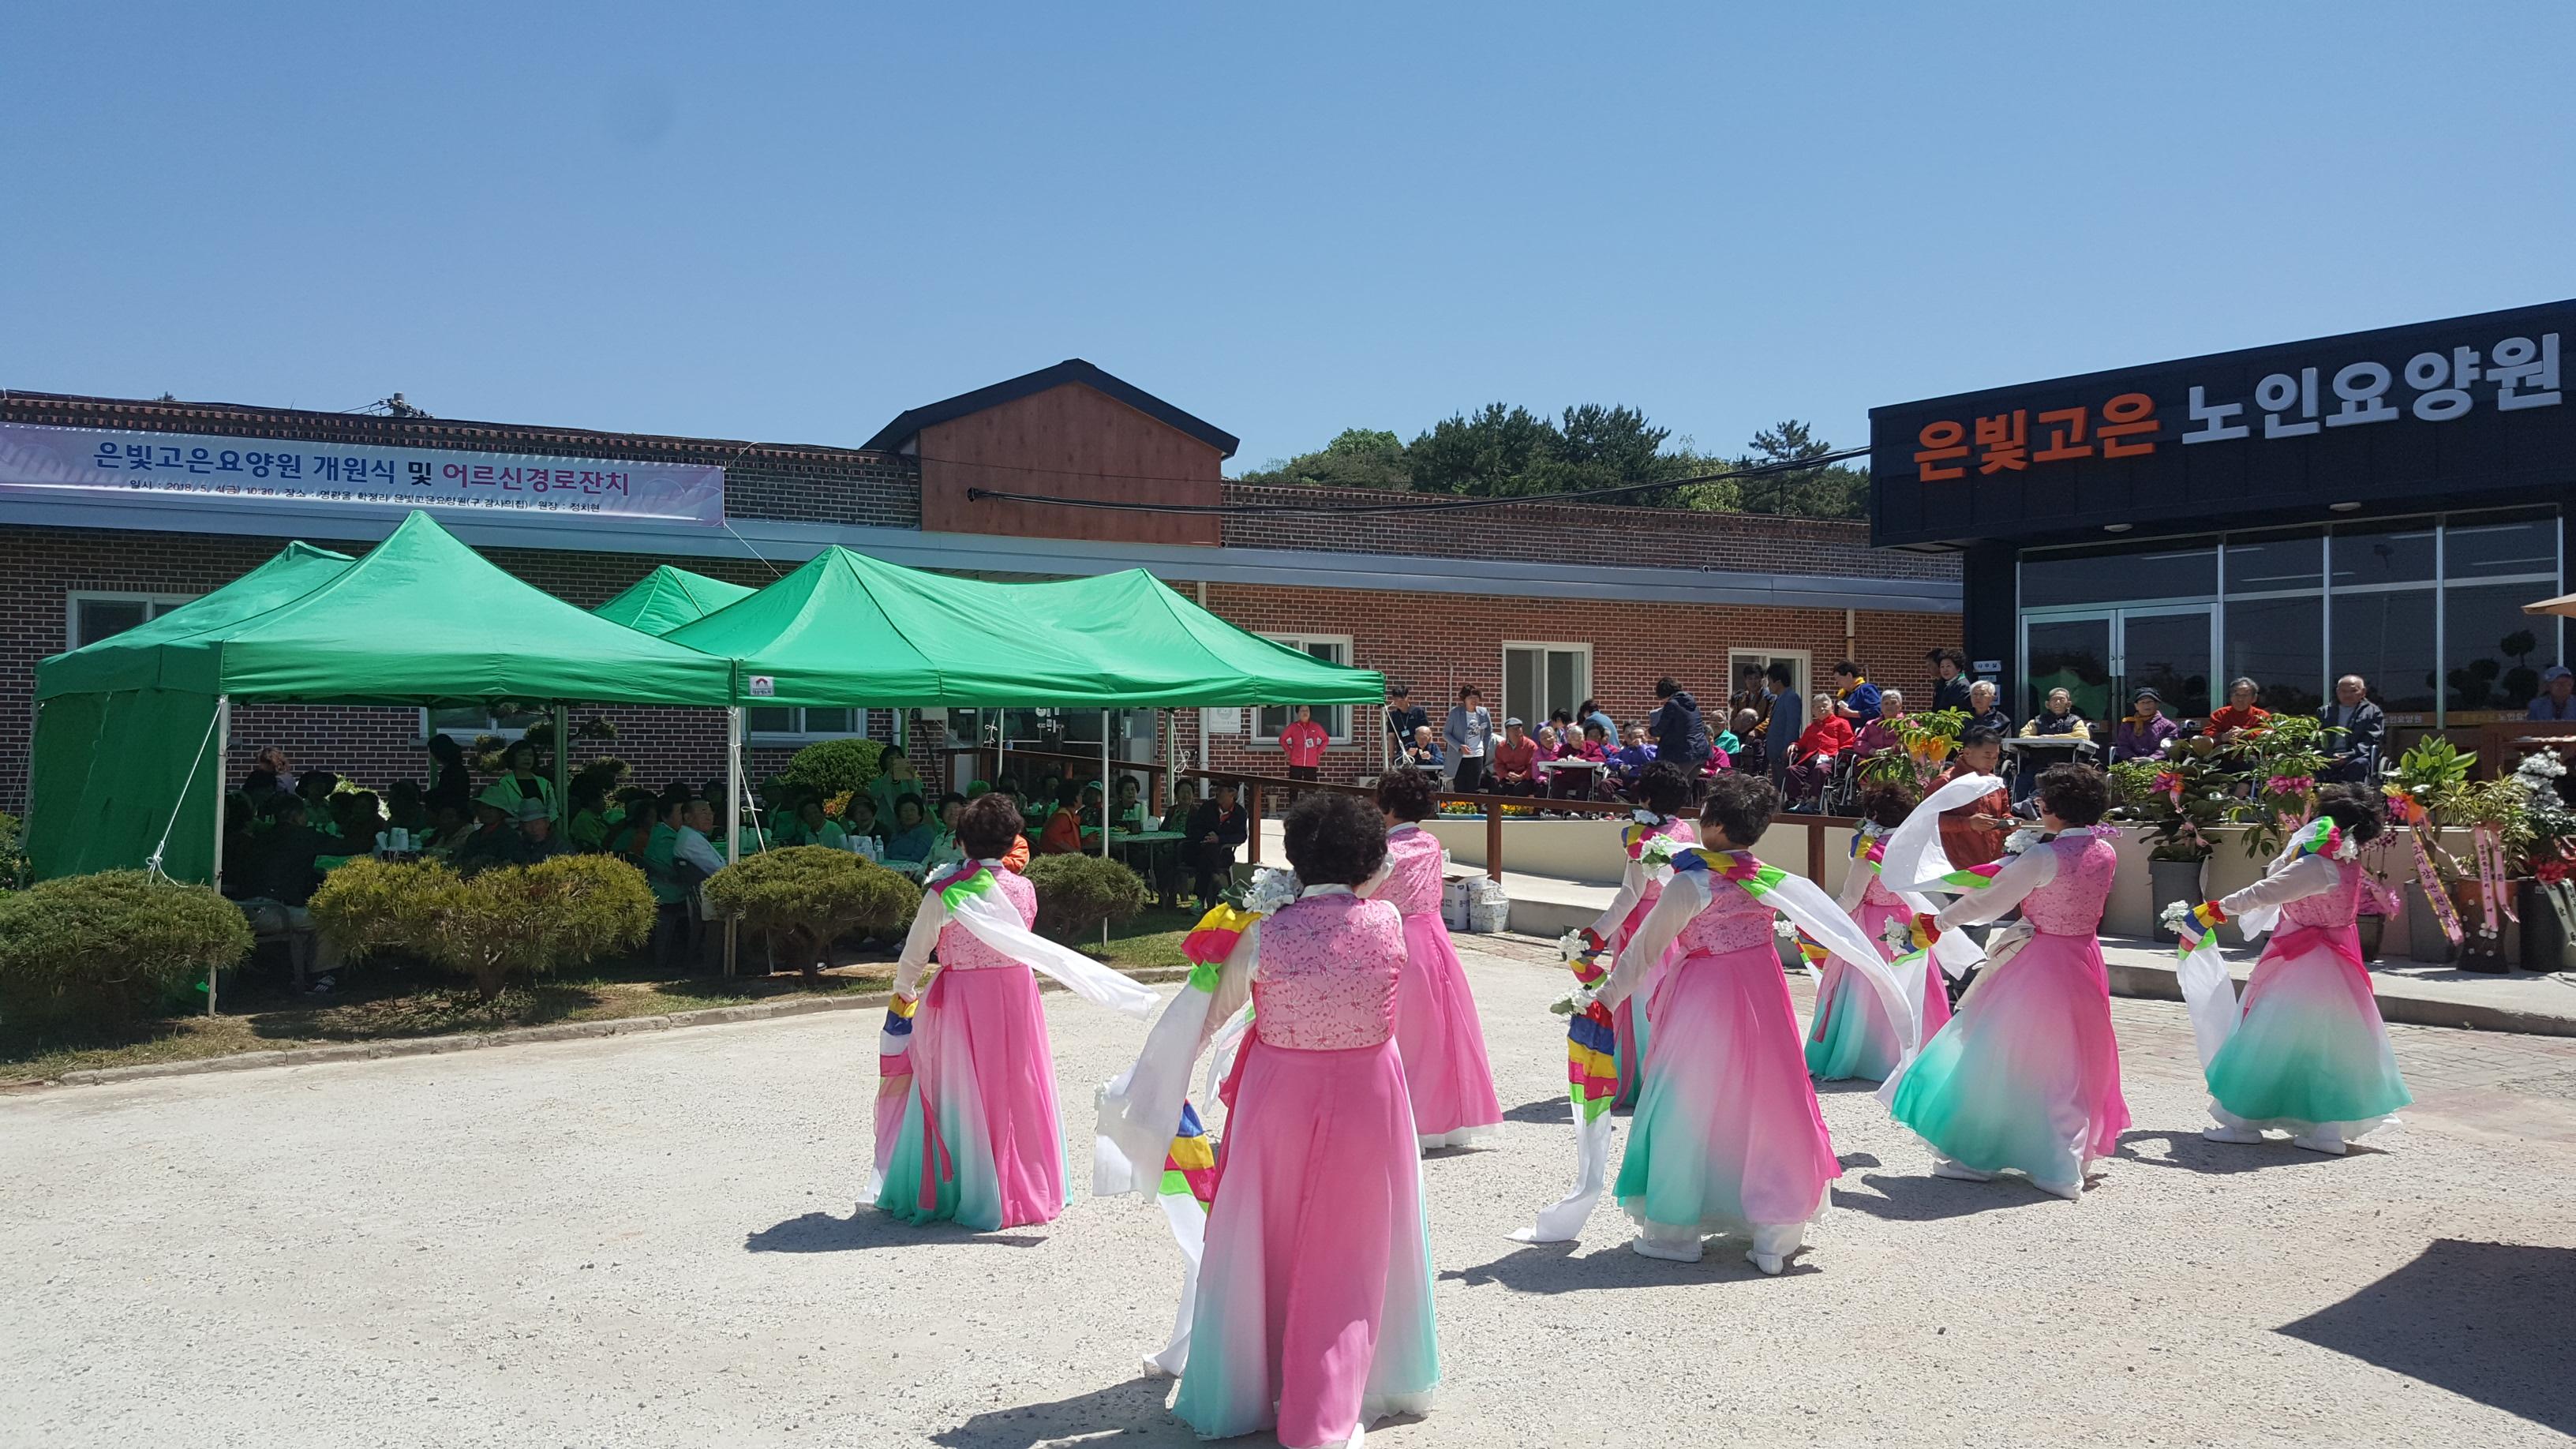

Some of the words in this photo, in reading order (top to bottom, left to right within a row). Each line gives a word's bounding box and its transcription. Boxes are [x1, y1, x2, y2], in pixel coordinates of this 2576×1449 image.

[1913, 392, 2161, 482] 은빛고은
[2181, 332, 2563, 445] 노인요양원
[93, 441, 302, 480] 은빛고은요양원
[313, 455, 395, 485] 개원식
[408, 461, 432, 487] 및
[442, 462, 630, 496] 어르신경로잔치
[129, 480, 152, 490] 일시
[215, 485, 241, 495] 4(금)
[285, 488, 306, 498] 장소
[320, 490, 351, 500] 영광읍
[537, 500, 558, 511] 원장
